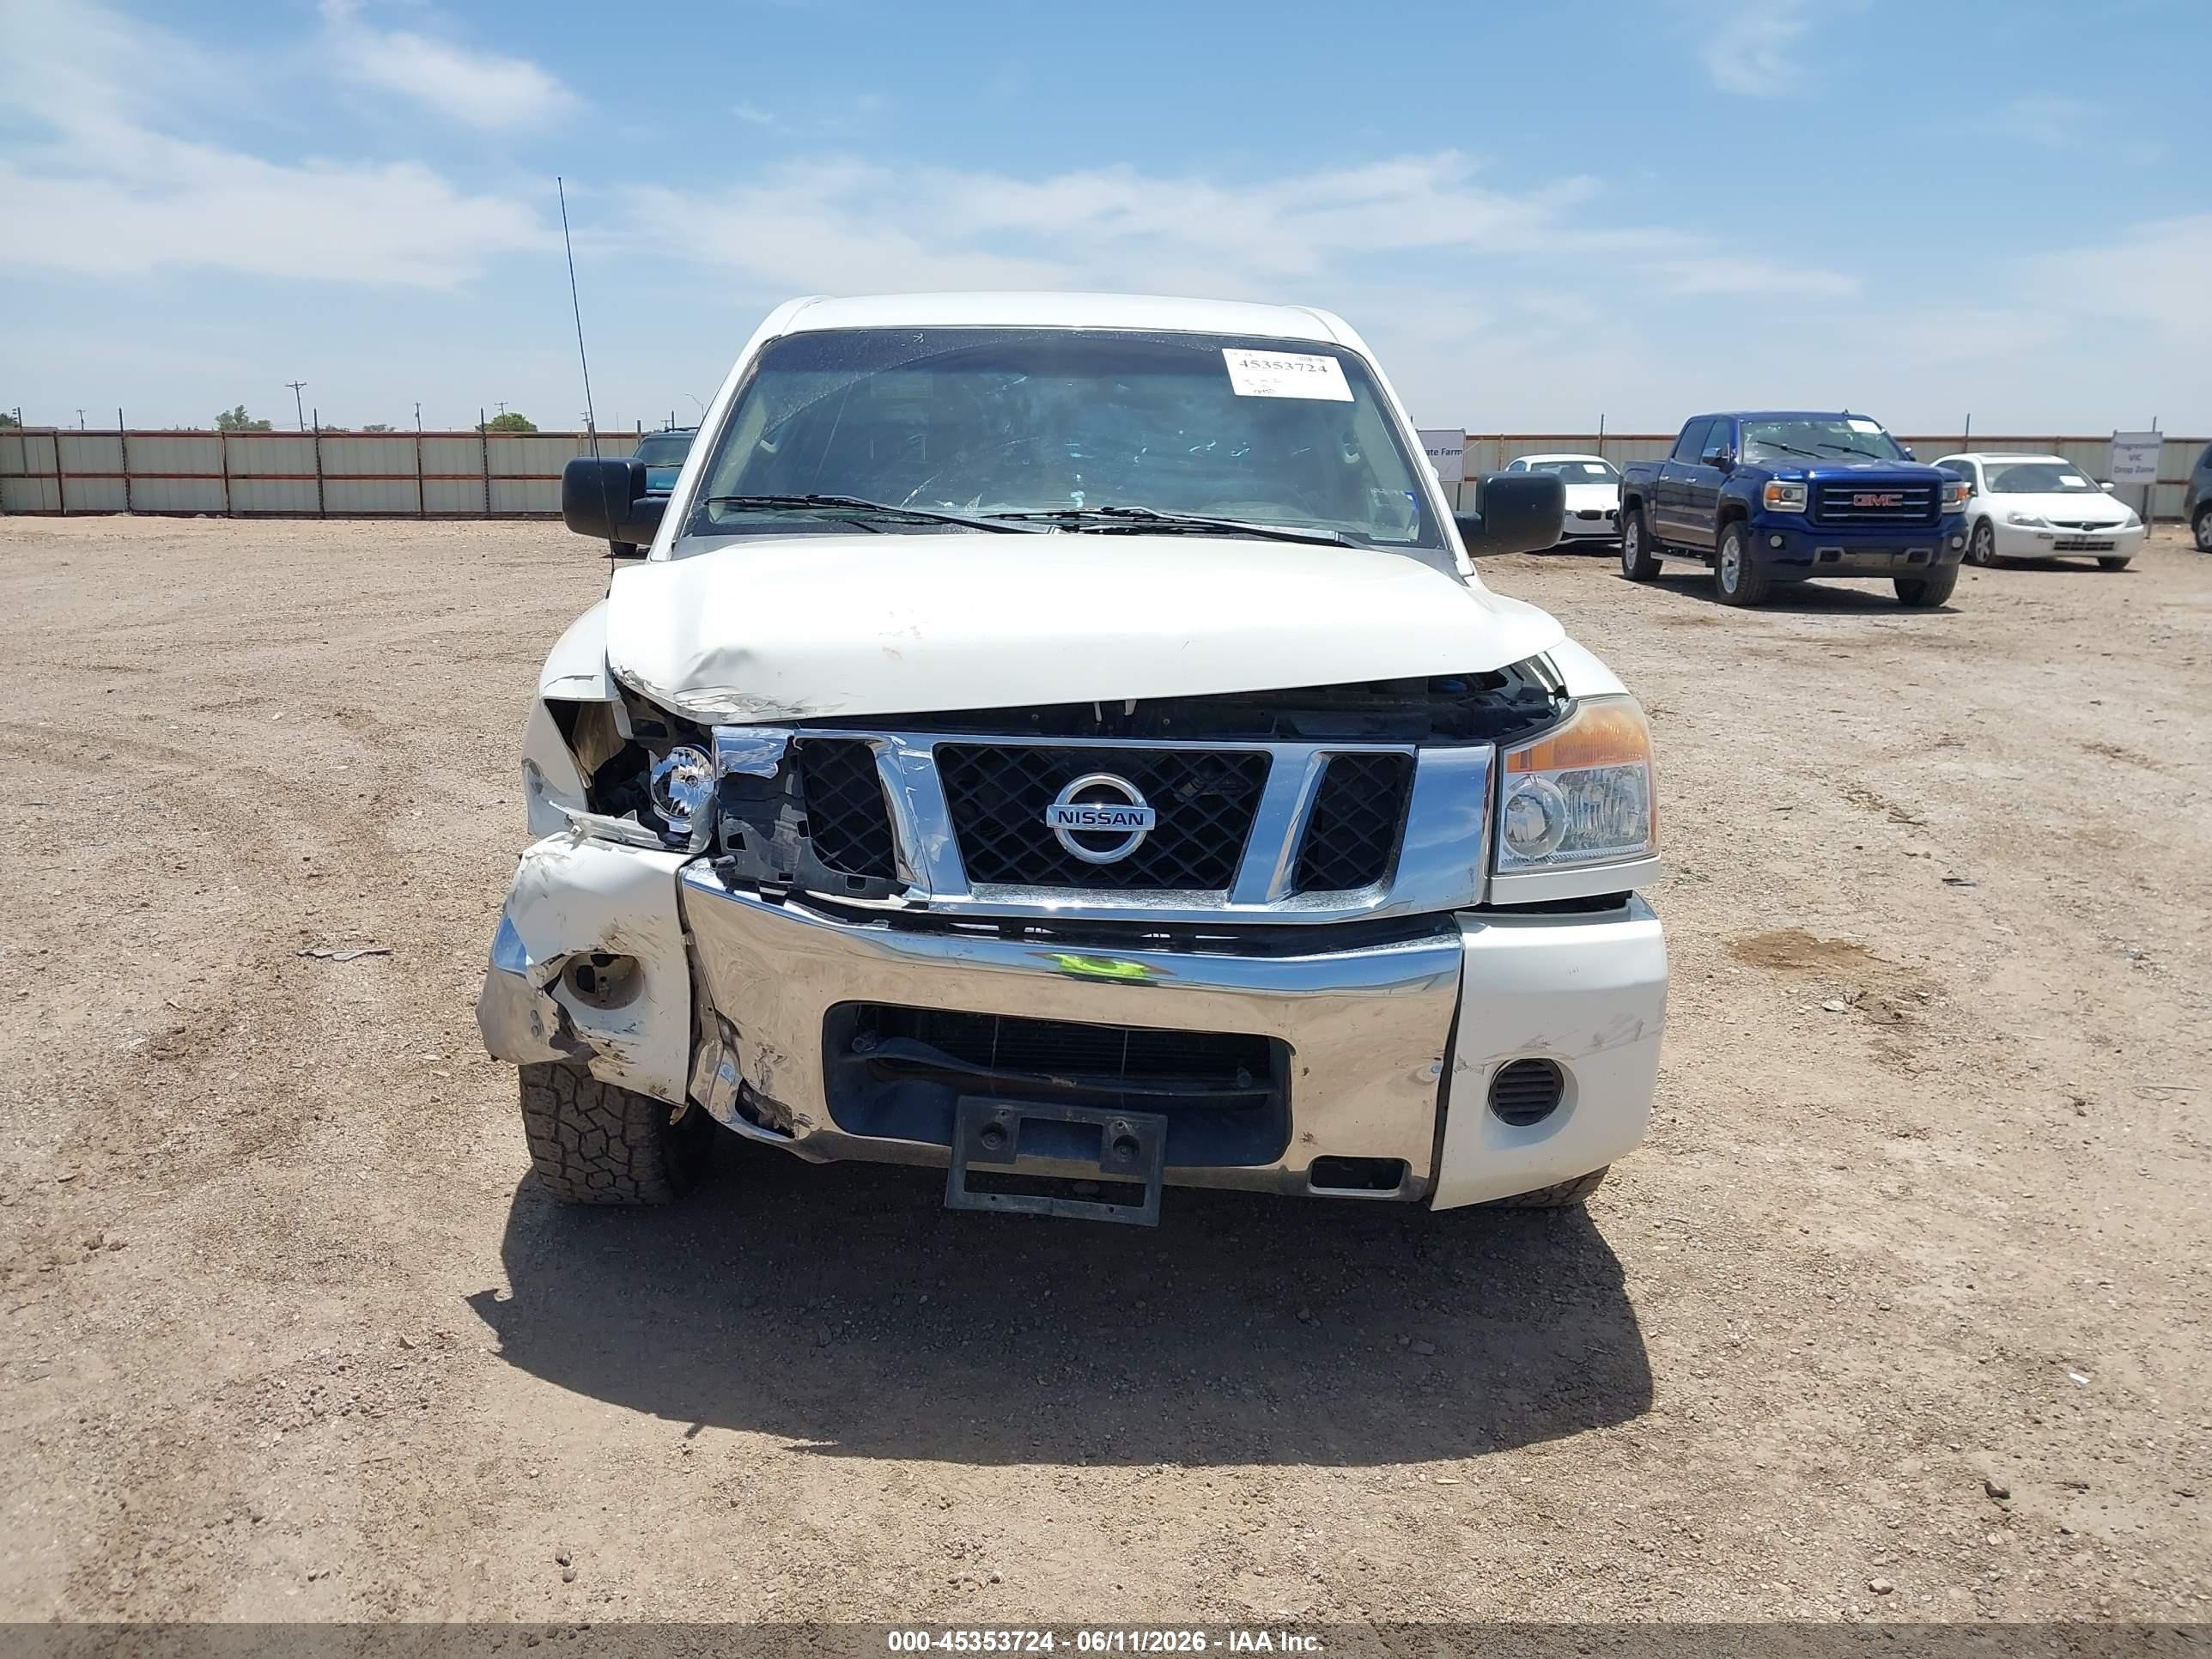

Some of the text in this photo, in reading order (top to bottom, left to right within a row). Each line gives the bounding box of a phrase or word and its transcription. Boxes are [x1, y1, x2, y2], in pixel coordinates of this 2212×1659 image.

[1239, 359, 1328, 373] 45353724
[1853, 494, 1903, 507] GMC
[1058, 811, 1144, 826] NISSAN
